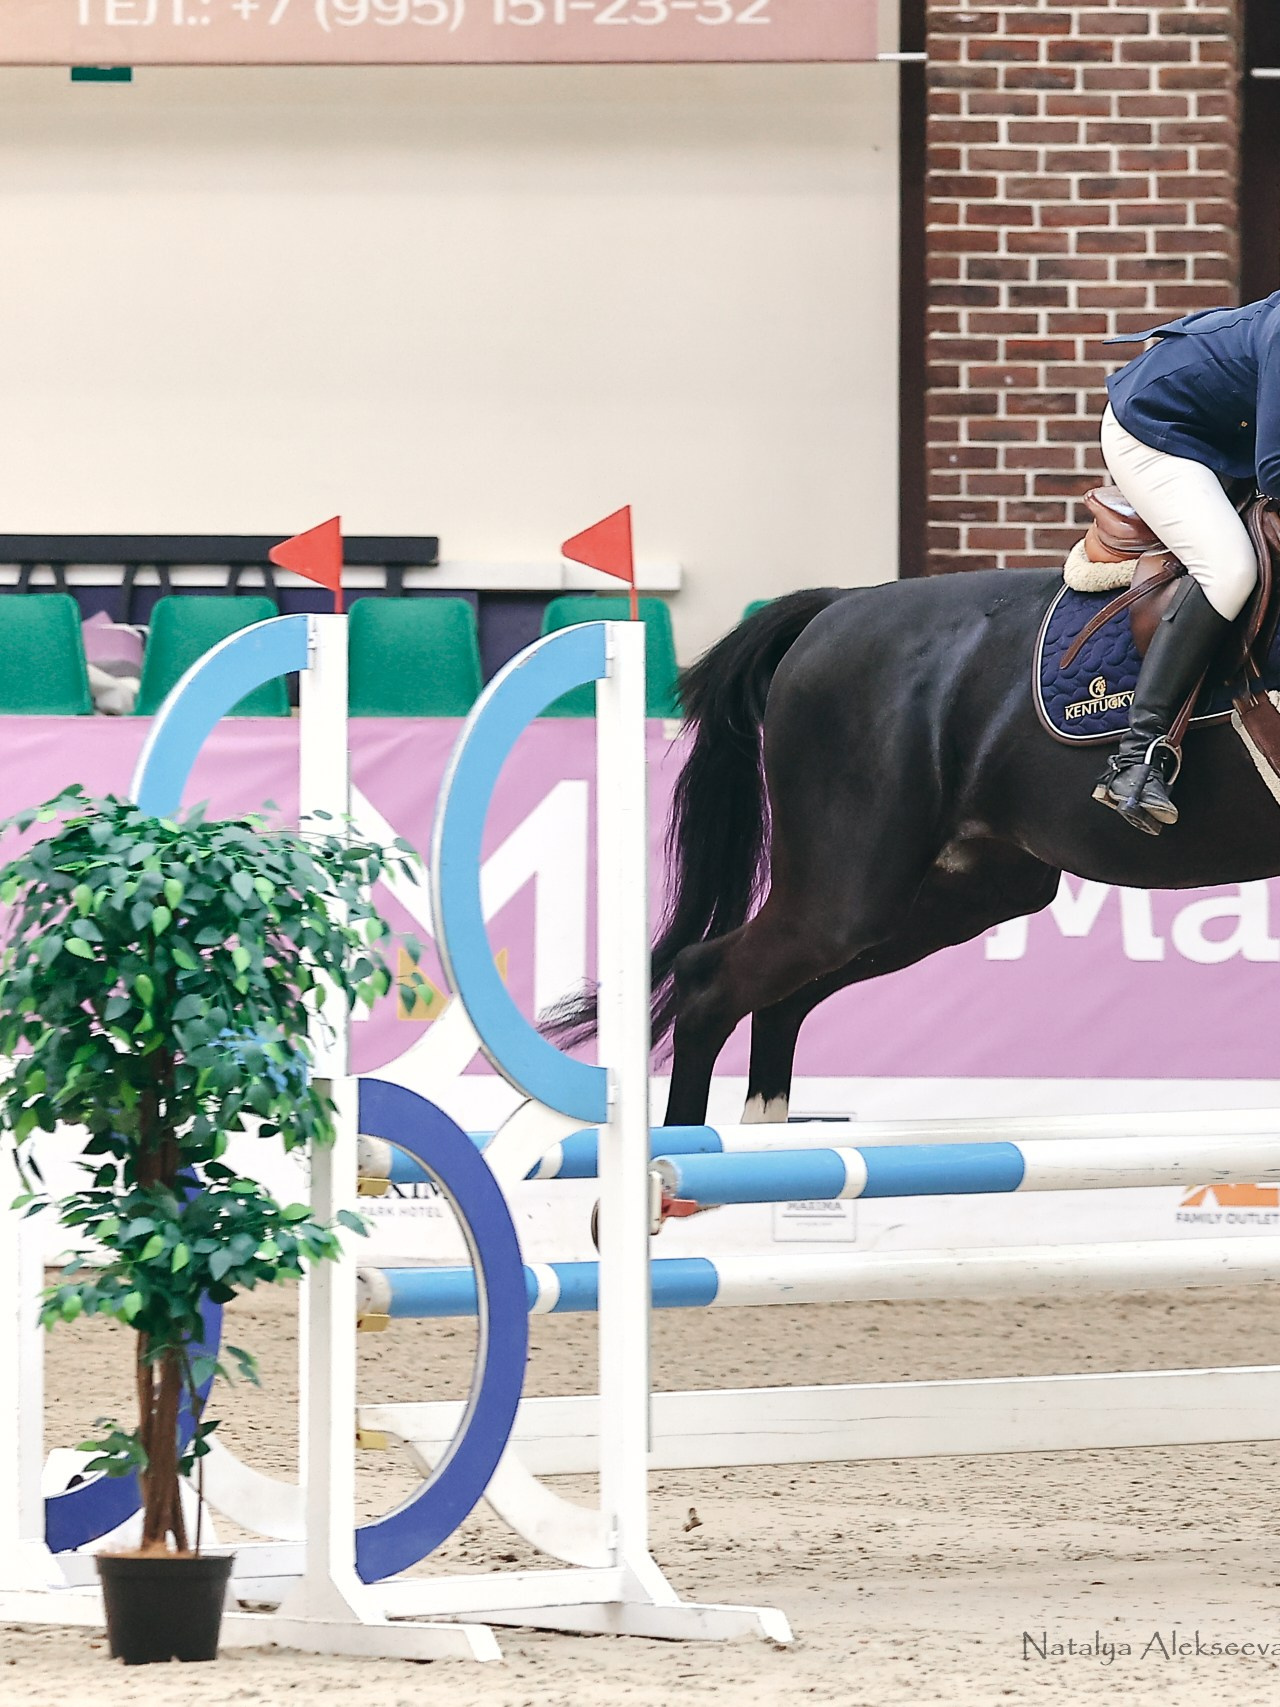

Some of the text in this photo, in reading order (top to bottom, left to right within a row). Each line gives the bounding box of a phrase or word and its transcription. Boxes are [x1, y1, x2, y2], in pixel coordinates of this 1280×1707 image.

[1064, 692, 1135, 721] KENTUCKY
[1176, 1212, 1280, 1225] FAMILY OUTLET
